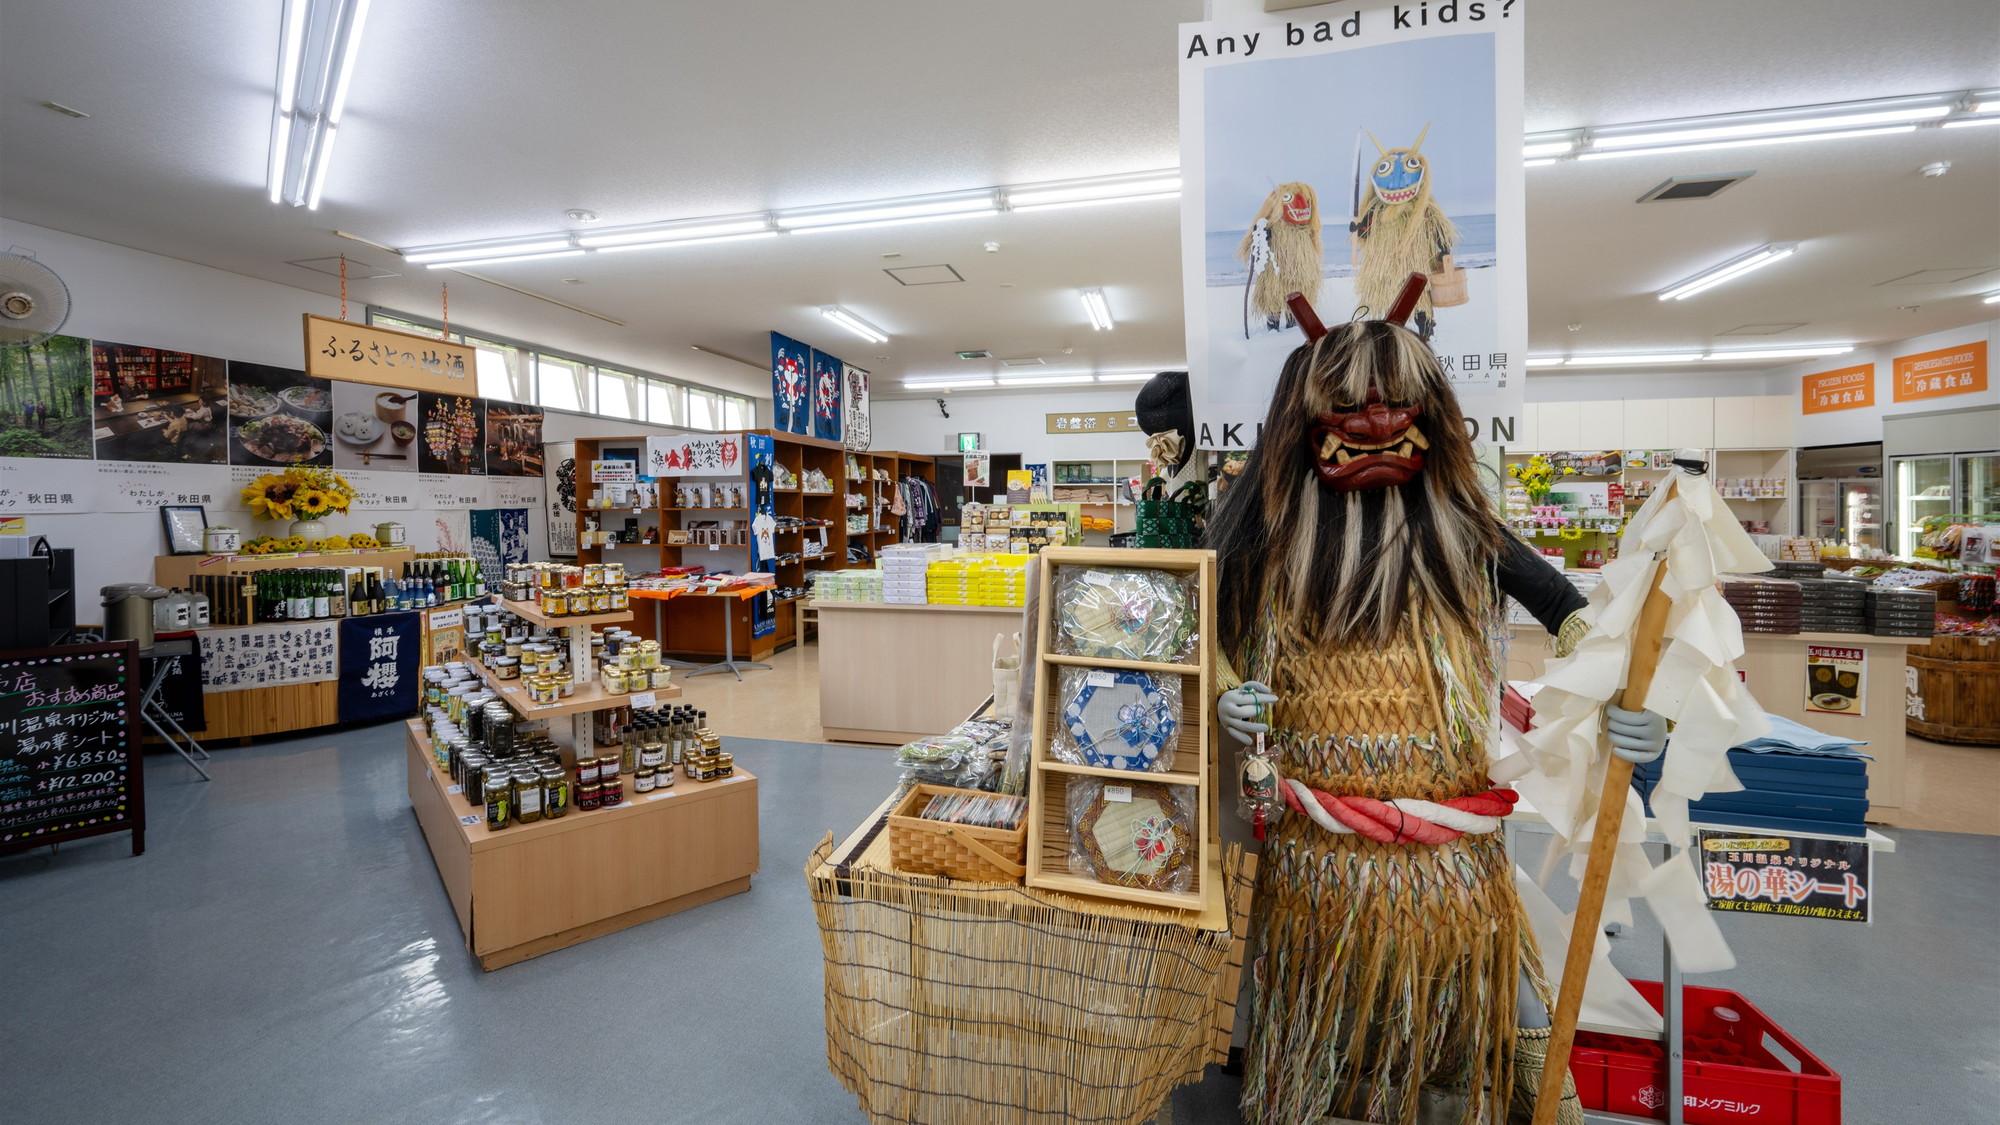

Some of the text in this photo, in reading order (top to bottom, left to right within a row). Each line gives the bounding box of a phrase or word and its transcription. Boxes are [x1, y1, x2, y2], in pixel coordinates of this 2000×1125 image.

[1187, 0, 1516, 58] Any bad kids?
[322, 336, 465, 380] ふるさとの地酒
[1436, 353, 1507, 371] 秋田県
[1953, 351, 1974, 364] FOODS
[1818, 372, 1865, 388] FROZEN FOODS
[1905, 372, 1912, 385] 2
[1916, 372, 1972, 393] 冷蔵食品
[1819, 390, 1865, 406] 冷凍食品
[1056, 417, 1096, 429] 岩盤浴
[27, 493, 74, 504] 秋田県
[177, 495, 212, 504] 秋田県
[1089, 572, 1105, 580] ¥850
[1090, 672, 1107, 680] ¥850
[25, 683, 119, 707] おすすめ商品
[371, 689, 395, 698] あざくら
[17, 731, 113, 755] 湯の華シート
[37, 761, 51, 770] 小
[1107, 787, 1124, 795] ¥850
[1728, 852, 1851, 870] 玉川温泉オリジナル
[1706, 863, 1867, 909] 湯の華シート
[1683, 1095, 1760, 1115] 印メグミルク
